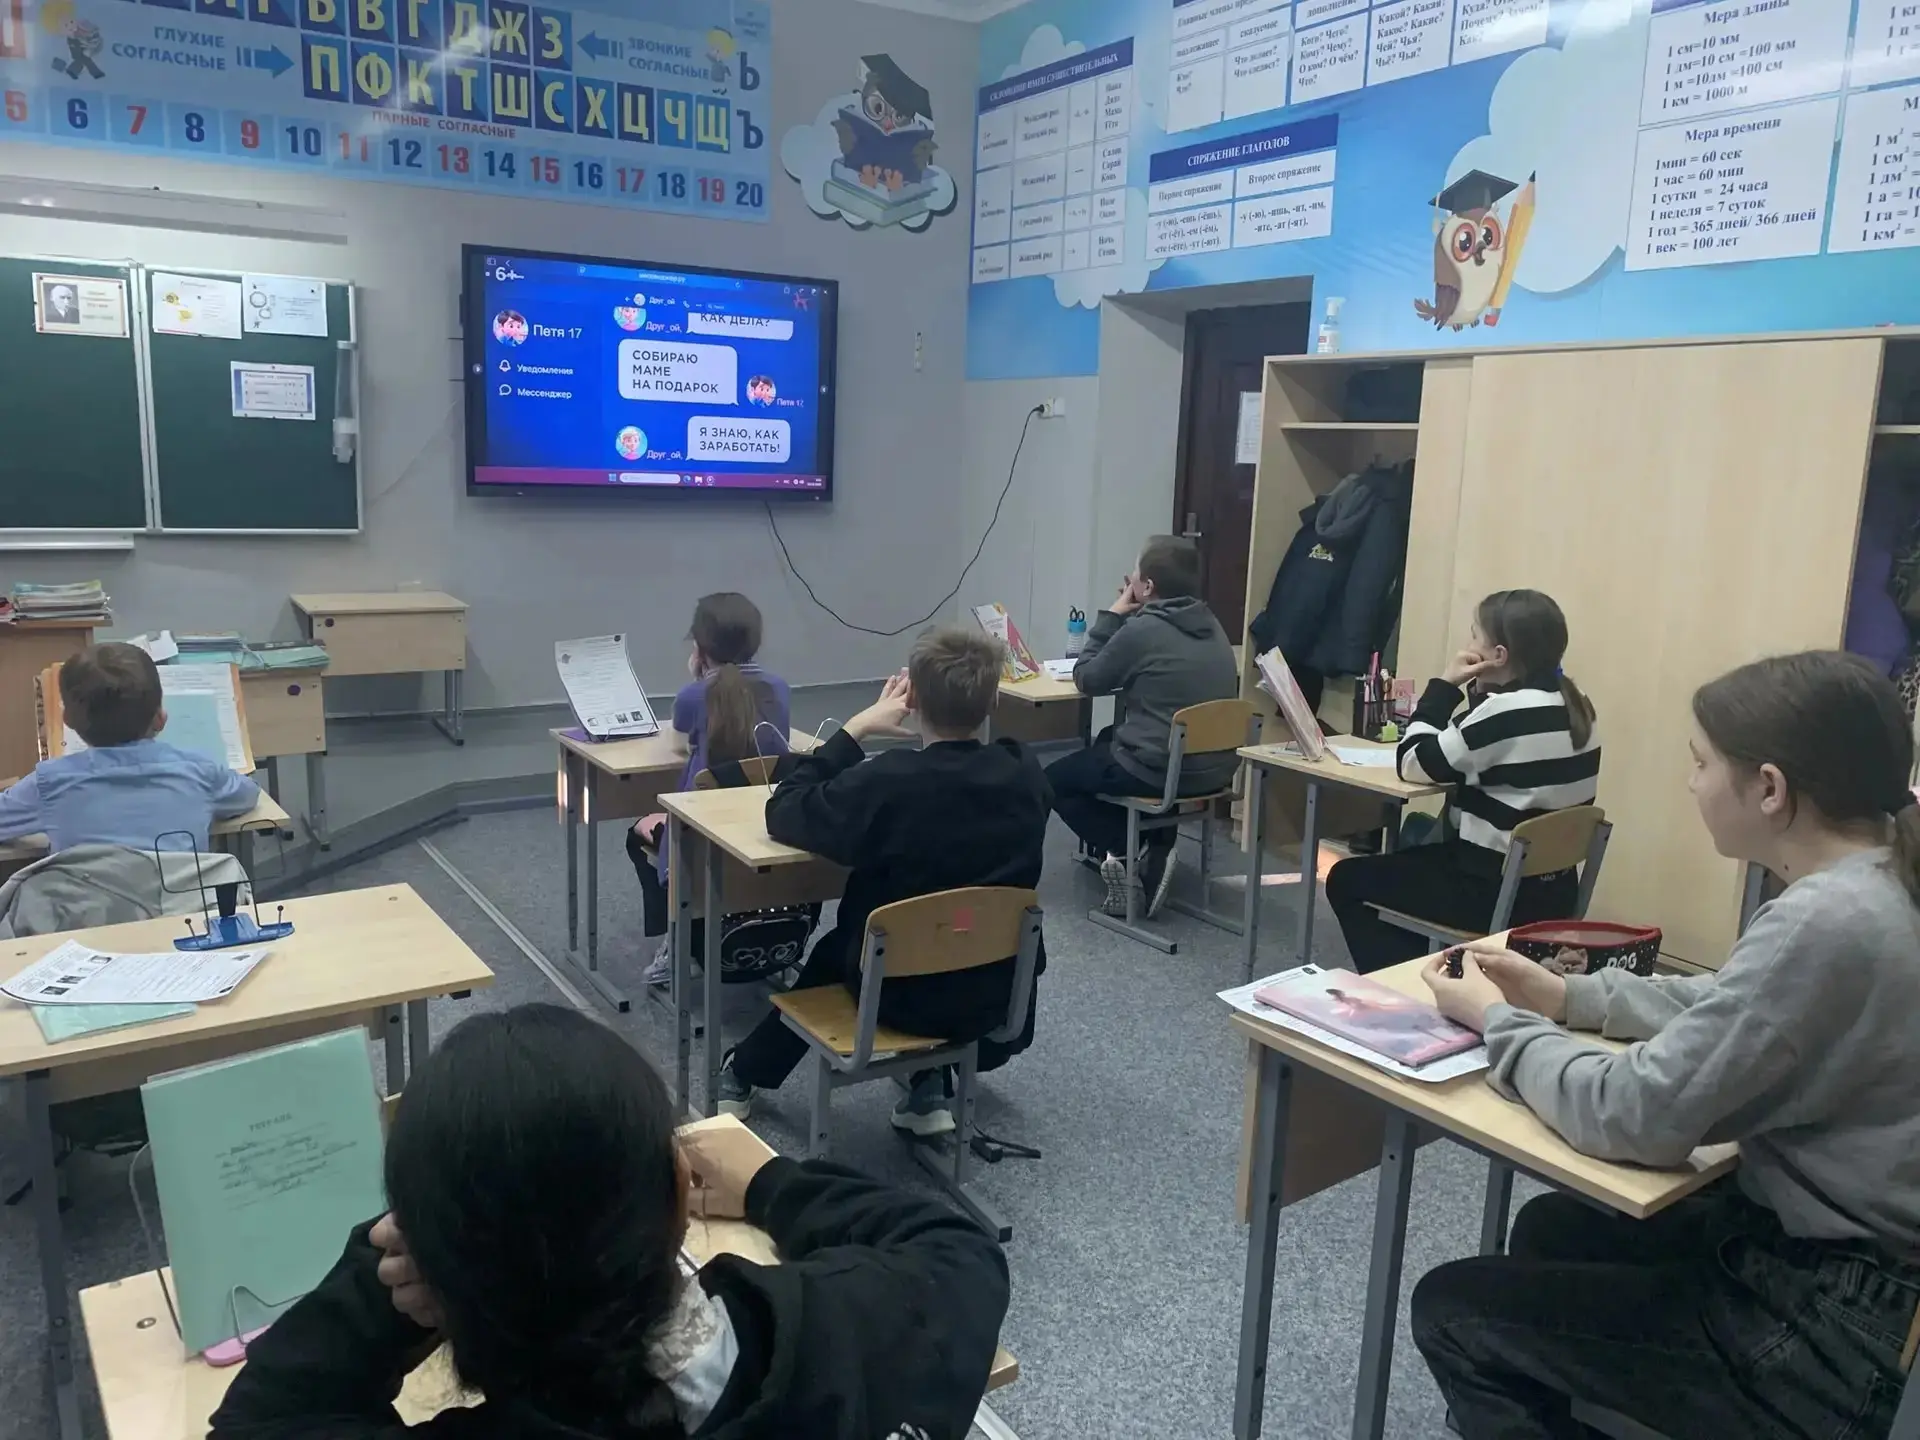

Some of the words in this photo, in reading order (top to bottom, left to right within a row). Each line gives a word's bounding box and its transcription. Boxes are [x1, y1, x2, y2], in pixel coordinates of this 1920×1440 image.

[1378, 5, 1411, 25] Какой?
[1704, 9, 1739, 24] Мера
[1743, 0, 1790, 16] длины
[1890, 6, 1896, 19] 1
[358, 0, 385, 30] В
[408, 0, 428, 37] Г
[449, 2, 481, 52] Д
[492, 8, 527, 56] Ж
[541, 16, 563, 59] З
[1325, 24, 1349, 39] Чего?
[1377, 21, 1409, 40] Какое?
[1411, 12, 1445, 30] Какие?
[1888, 25, 1894, 38] 1
[155, 26, 225, 48] ГЛУХИЕ
[1327, 38, 1352, 52] Чему?
[1376, 38, 1398, 54] Чей?
[1400, 31, 1424, 47] Чья?
[1668, 46, 1673, 57] 1
[1677, 36, 1716, 55] см=10
[1720, 33, 1740, 46] мм
[112, 43, 226, 70] СОГЛАСНЫЕ
[628, 37, 692, 58] ЗВОНКИЕ
[1399, 47, 1422, 61] Чьи?
[1666, 63, 1671, 74] 1
[1675, 54, 1715, 74] дм=10
[1718, 52, 1735, 64] см
[1739, 42, 1771, 57] =100
[1774, 39, 1796, 51] мм
[628, 57, 709, 80] СОГЛАСНЫЕ
[1299, 64, 1306, 74] О
[1307, 58, 1327, 72] ком?
[1329, 57, 1337, 66] О
[1338, 50, 1359, 64] чём?
[1298, 74, 1318, 87] Что?
[1664, 80, 1669, 92] 1
[1674, 80, 1683, 91] м
[1765, 60, 1783, 73] см
[311, 44, 340, 92] П
[356, 52, 392, 99] Ф
[408, 60, 434, 105] К
[455, 68, 478, 111] Т
[494, 72, 528, 118] Ш
[544, 82, 564, 124] С
[584, 86, 607, 129] Х
[624, 92, 648, 140] Ц
[664, 98, 686, 140] Ч
[697, 104, 729, 150] Щ
[1663, 98, 1667, 109] 1
[1672, 95, 1689, 107] км
[1705, 85, 1733, 101] 1000
[1737, 85, 1748, 95] м
[372, 111, 430, 128] ПАРНЫЕ
[438, 120, 516, 138] СОГЛАСНЫЕ
[737, 109, 763, 149] Ъ
[1685, 129, 1719, 143] Мера
[1723, 118, 1781, 139] времени
[5, 89, 27, 122] 5
[67, 98, 89, 129] 6
[126, 105, 147, 135] 7
[184, 112, 205, 142] 8
[240, 119, 260, 148] 9
[286, 125, 321, 156] 10
[338, 132, 368, 162] 11
[387, 138, 422, 168] 12
[438, 144, 469, 173] 13
[484, 151, 515, 179] 14
[531, 156, 560, 183] 15
[574, 161, 603, 189] 16
[616, 167, 645, 193] 17
[657, 172, 685, 198] 18
[698, 177, 725, 202] 19
[736, 182, 763, 207] 20
[1874, 134, 1880, 146] 1
[1187, 146, 1241, 167] СПРЯЖЕНИЕ
[1242, 135, 1290, 156] ГЛАГОЛОВ
[1702, 151, 1717, 164] 60
[1720, 149, 1743, 160] сек
[1872, 153, 1877, 166] 1
[1248, 174, 1275, 185] Второе
[1277, 165, 1322, 181] спряжение
[1654, 176, 1659, 187] 1
[1663, 175, 1684, 186] час
[1699, 168, 1714, 181] 60
[1717, 166, 1744, 178] мин
[1869, 172, 1875, 185] 1
[1159, 190, 1183, 202] Первое
[1184, 183, 1222, 198] спряжение
[1652, 193, 1657, 204] 1
[1661, 190, 1697, 206] сутки
[1720, 182, 1734, 196] 24
[1738, 181, 1769, 193] часа
[1867, 192, 1872, 204] 1
[1878, 193, 1887, 202] а
[1650, 210, 1655, 221] 1
[1659, 206, 1702, 220] неделя
[1718, 201, 1725, 213] 7
[1728, 198, 1767, 215] суток
[1864, 211, 1870, 223] 1
[1876, 211, 1892, 222] га
[1648, 227, 1653, 238] 1
[1657, 226, 1677, 238] год
[1691, 219, 1713, 233] 365
[1715, 215, 1752, 231] дней/
[1755, 212, 1779, 226] 366
[1782, 208, 1817, 225] дней
[1646, 244, 1651, 255] 1
[1656, 243, 1677, 254] век
[1693, 236, 1713, 250] 100
[1716, 236, 1739, 248] лет
[1861, 230, 1867, 241] 1
[533, 324, 565, 338] Петя
[568, 328, 583, 338] 17
[730, 315, 770, 327] ДЕЛА?
[632, 350, 698, 364] СОБИРАЮ
[517, 364, 574, 375] Уведомления
[632, 364, 671, 377] МАМЕ
[517, 388, 573, 399] Мессенджер
[632, 379, 651, 390] НА
[655, 380, 719, 394] ПОДАРОК
[700, 427, 707, 437] Я
[711, 428, 751, 439] ЗНАЮ,
[755, 430, 779, 440] КАК
[700, 440, 780, 453] ЗАРАБОТАТЬ!
